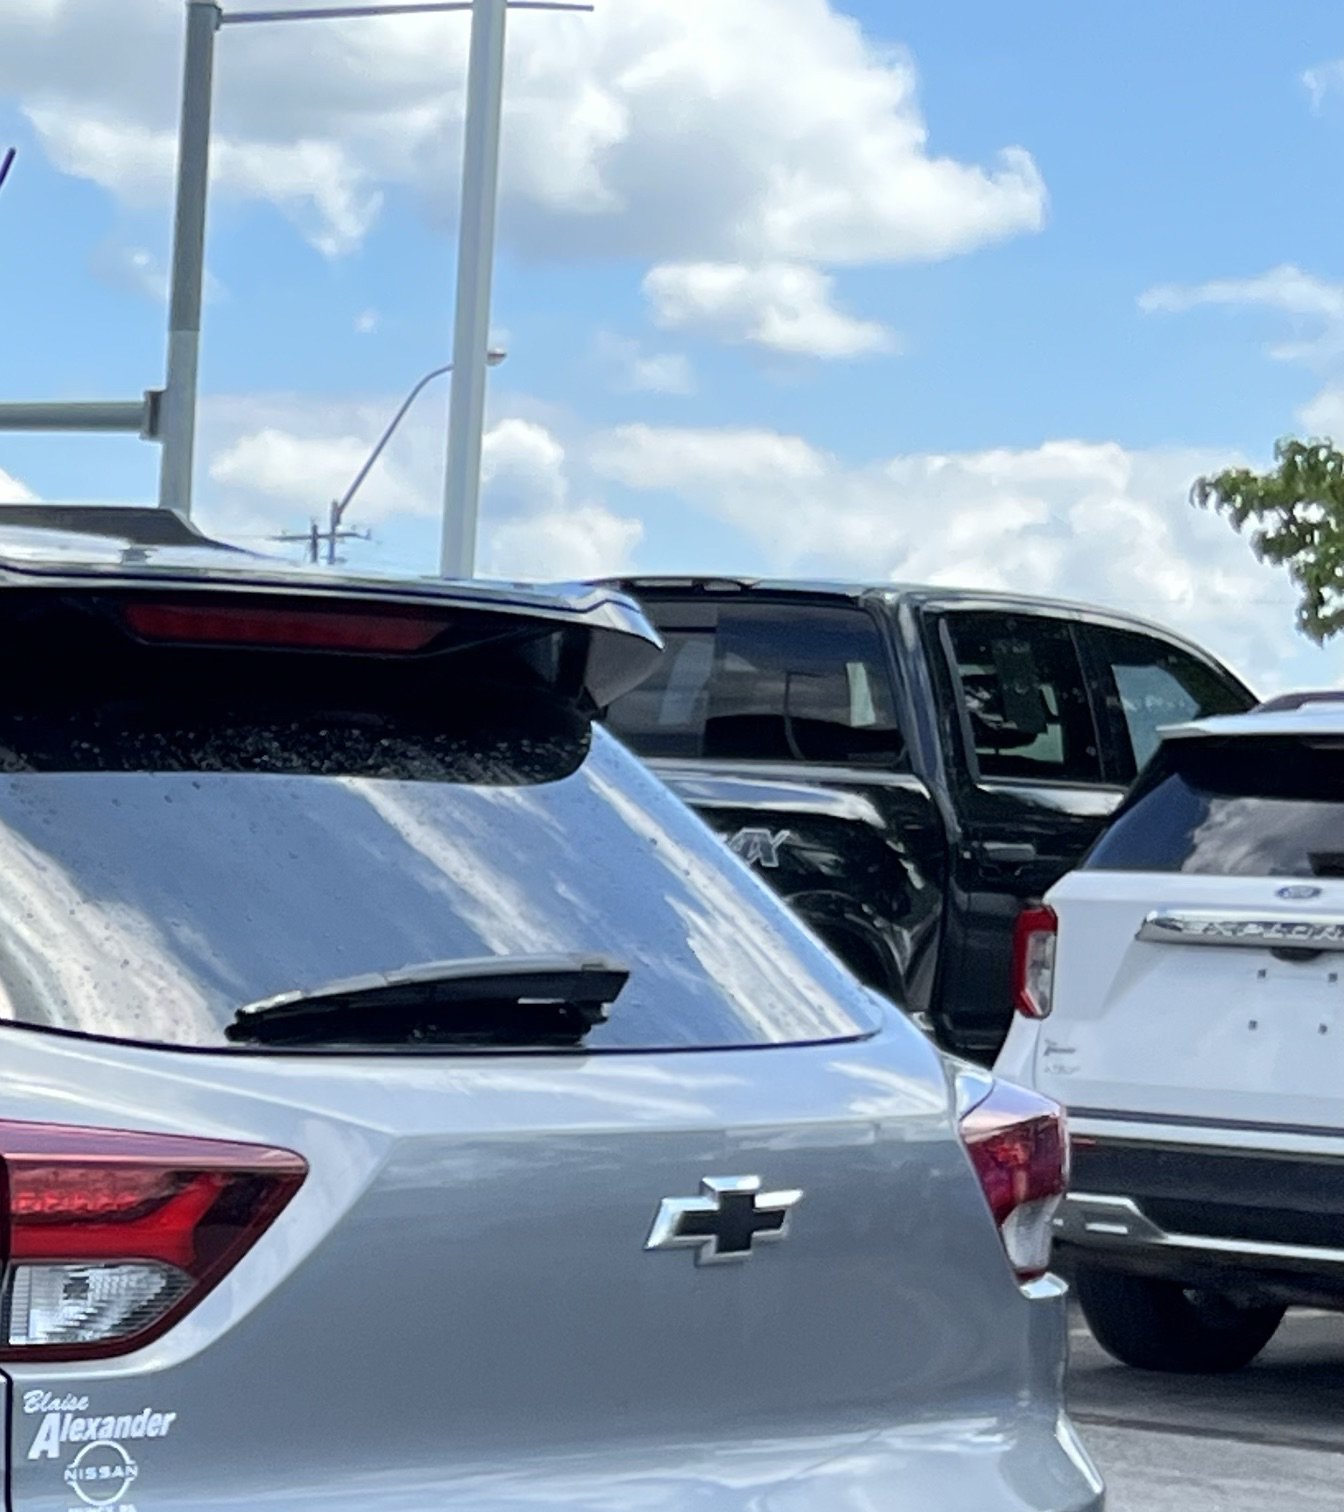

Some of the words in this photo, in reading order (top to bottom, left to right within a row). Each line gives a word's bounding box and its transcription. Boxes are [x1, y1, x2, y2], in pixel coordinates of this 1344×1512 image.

[24, 1390, 89, 1414] Blaise
[27, 1407, 176, 1460] Alexander
[64, 1465, 138, 1481] NISSAN
